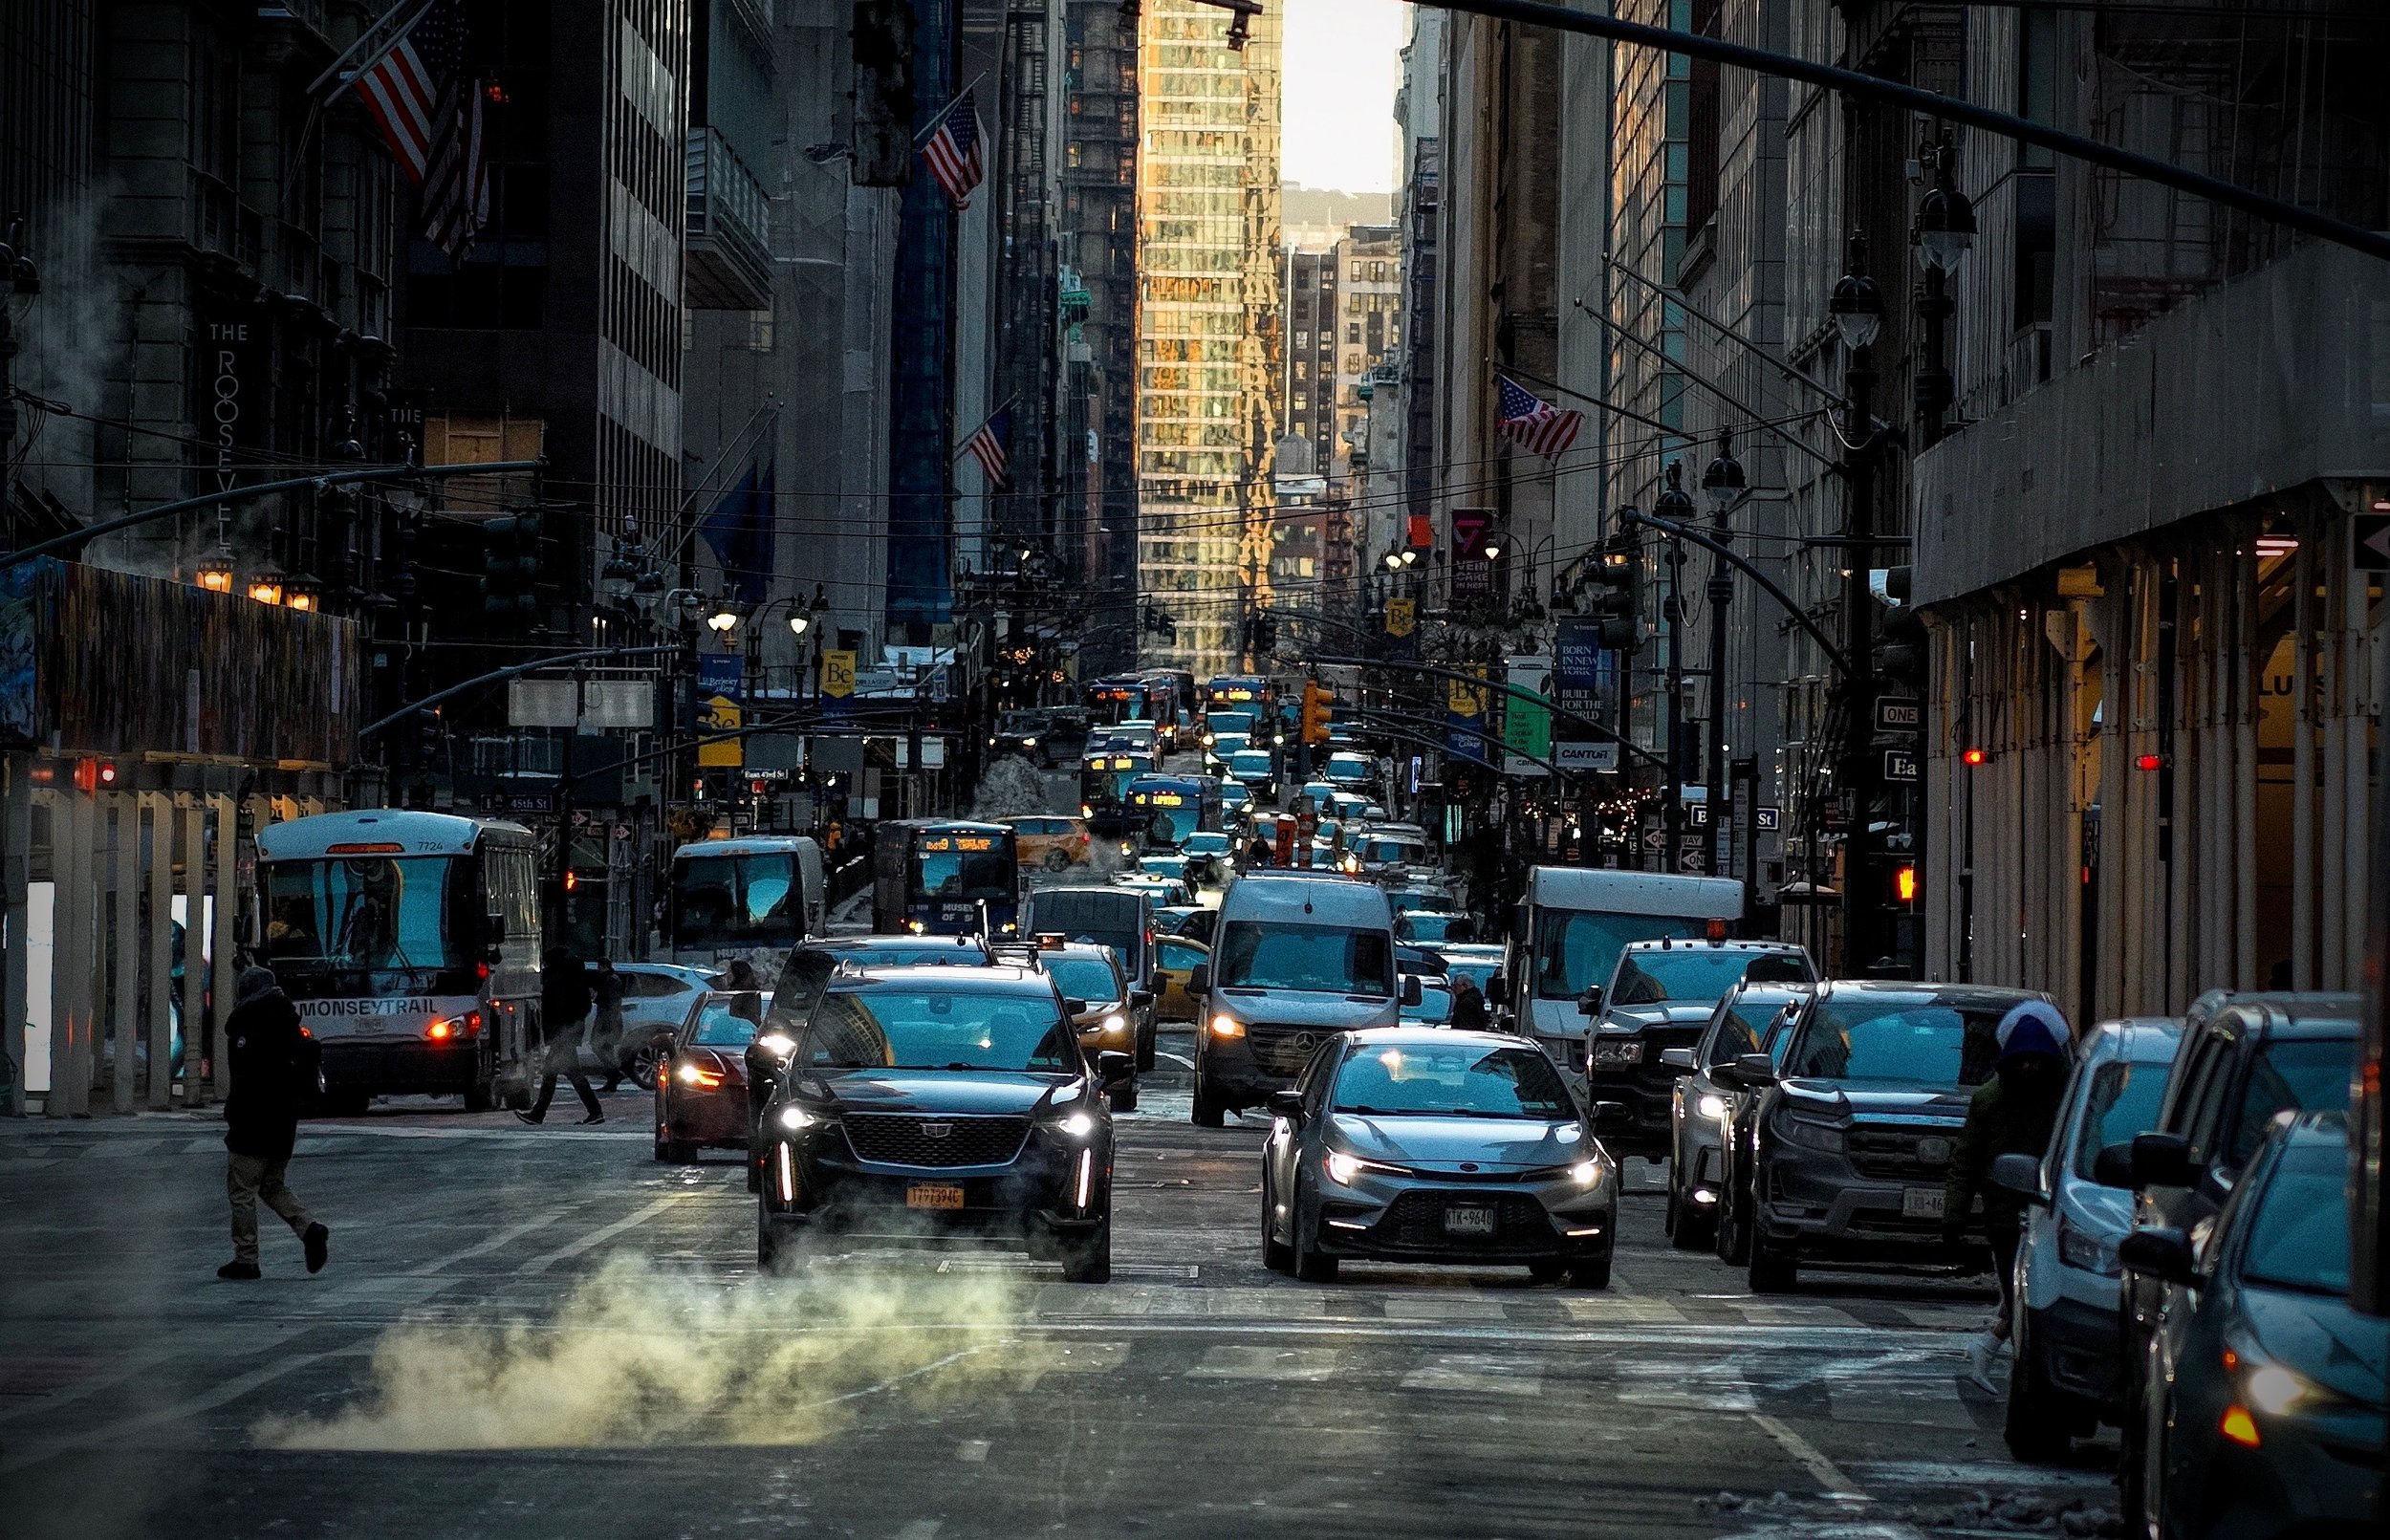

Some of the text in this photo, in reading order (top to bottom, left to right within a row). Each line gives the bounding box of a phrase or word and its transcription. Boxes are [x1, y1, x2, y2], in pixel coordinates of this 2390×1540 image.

[209, 323, 248, 340] THE
[390, 408, 422, 423] THE
[1562, 646, 1591, 655] BORN
[828, 663, 852, 683] Be
[1562, 666, 1591, 675] YORK
[1562, 689, 1590, 699] BUILT
[1562, 701, 1603, 709] FOR THE
[1573, 711, 1599, 720] ORLD
[1887, 708, 1917, 723] ONE
[1562, 749, 1608, 758] CANTOR
[510, 799, 548, 809] 45th St
[1757, 813, 1772, 826] St
[418, 842, 443, 851] 7724
